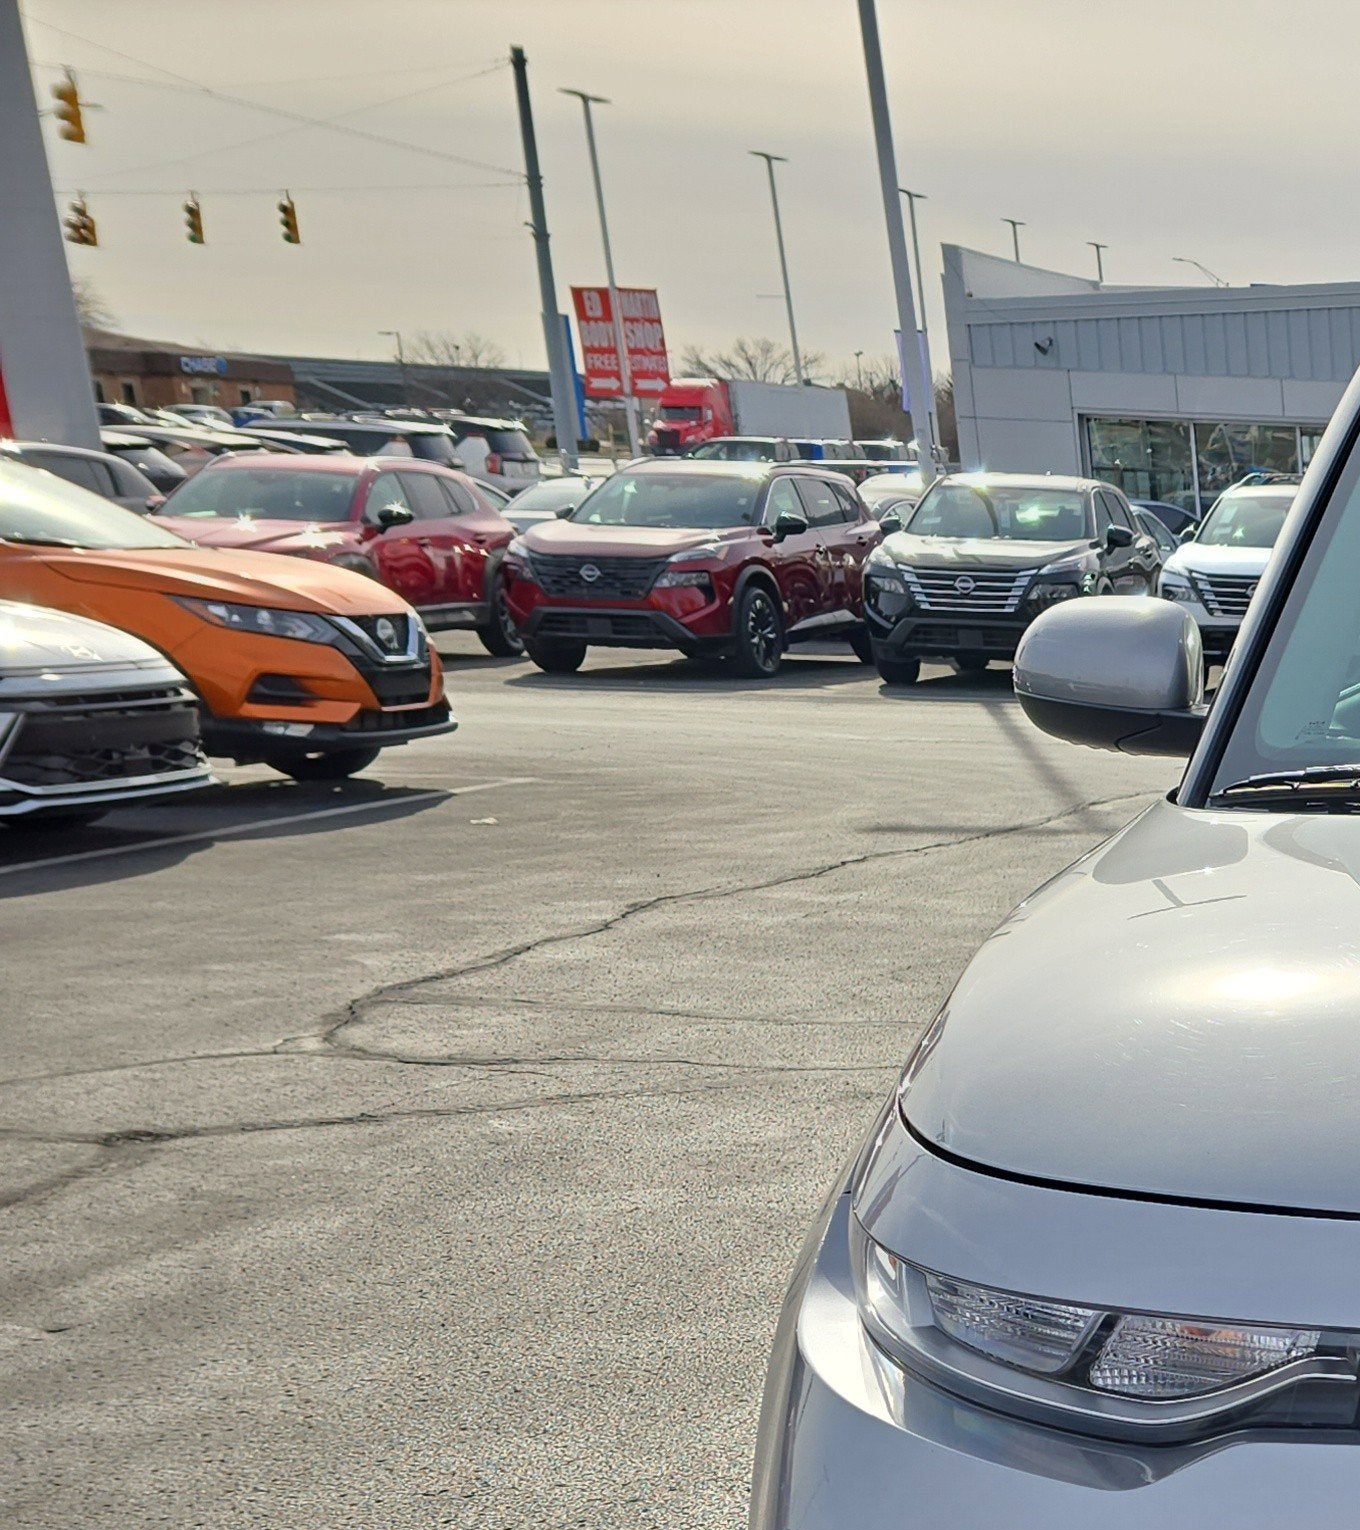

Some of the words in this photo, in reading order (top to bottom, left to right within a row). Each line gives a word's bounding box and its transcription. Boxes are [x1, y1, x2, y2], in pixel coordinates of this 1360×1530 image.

[582, 290, 602, 317] ED
[619, 291, 659, 317] MARTIN
[580, 320, 615, 347] BODY
[624, 320, 662, 350] SHOP
[180, 357, 217, 374] CHASE
[586, 352, 619, 371] FREE
